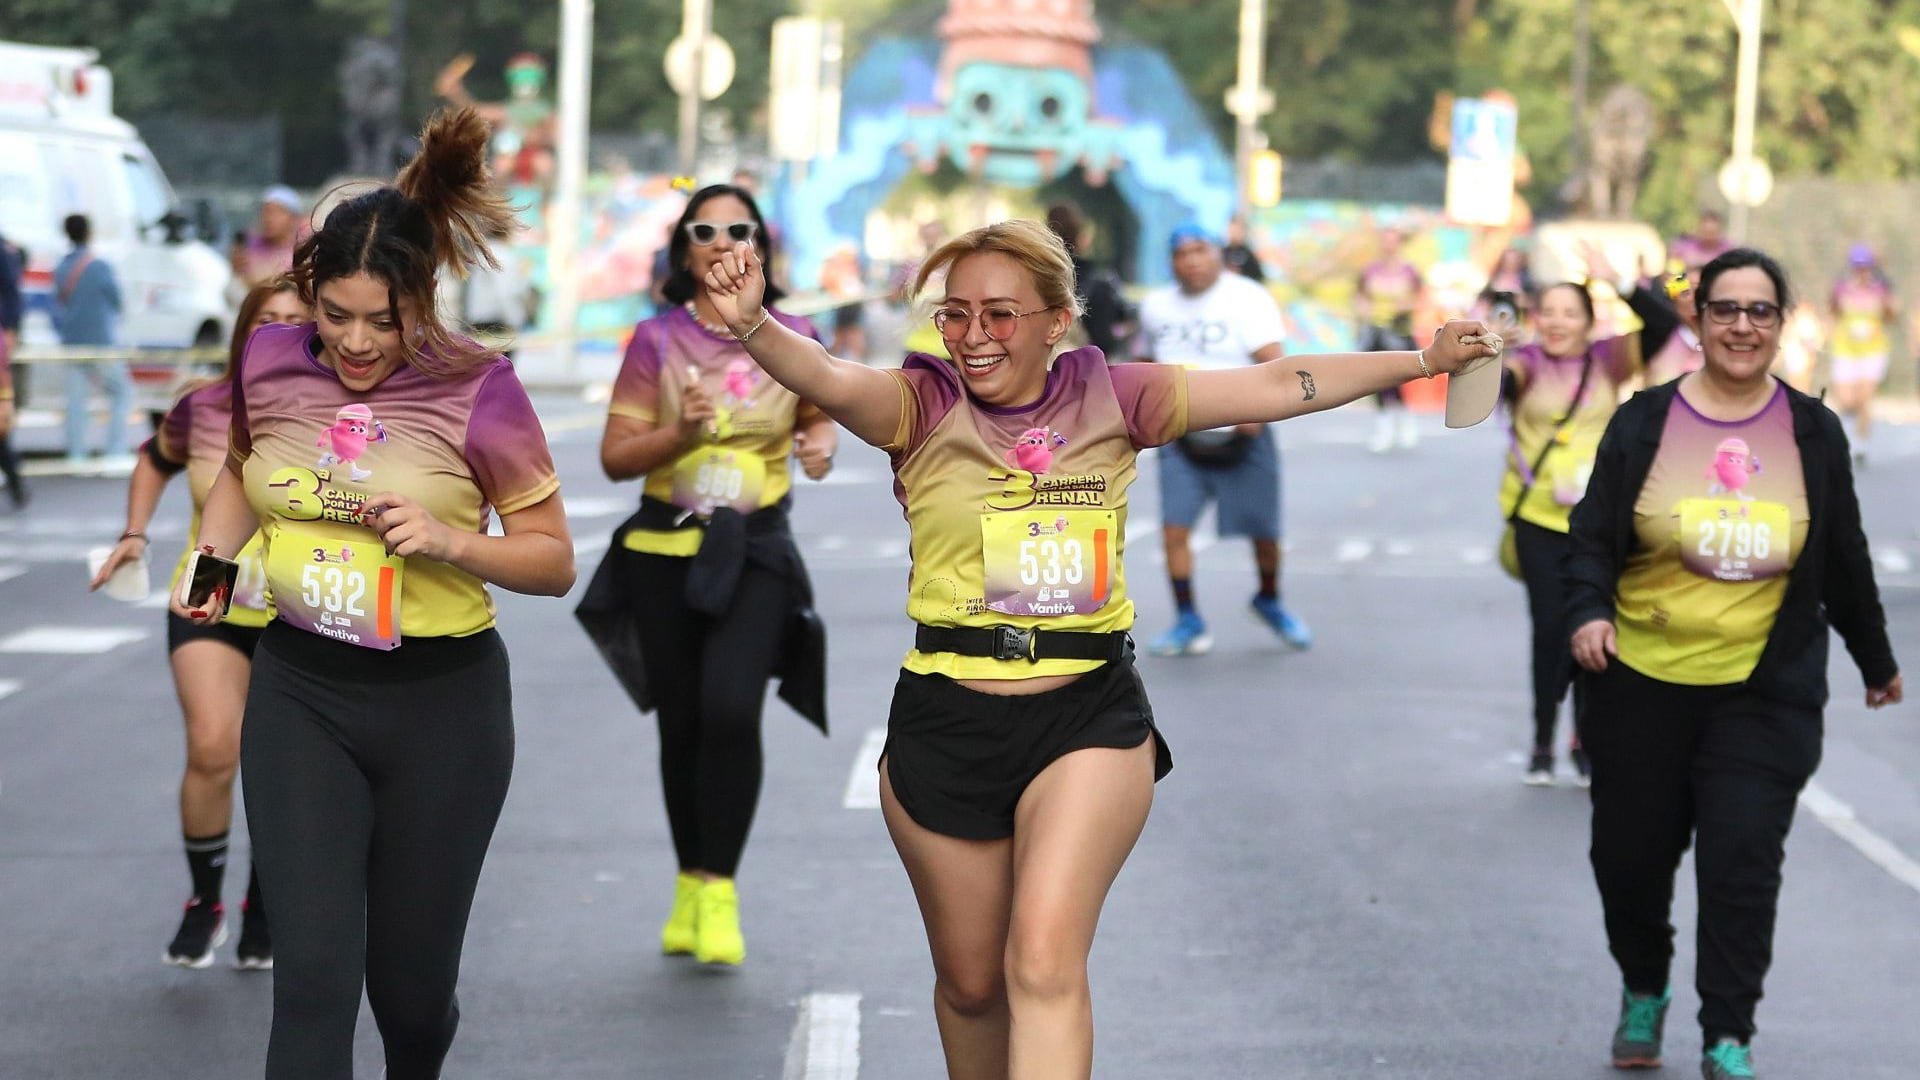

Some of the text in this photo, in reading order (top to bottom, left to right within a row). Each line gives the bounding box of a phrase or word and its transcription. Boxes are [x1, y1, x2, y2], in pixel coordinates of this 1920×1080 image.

[1040, 475, 1105, 489] CARRERA
[325, 488, 369, 503] CARR
[1036, 491, 1102, 505] RENAL
[323, 499, 345, 509] POR
[323, 507, 364, 524] REN
[1697, 519, 1770, 560] 2796
[1019, 539, 1083, 586] 533
[301, 564, 366, 617] 532
[1027, 602, 1076, 614] Vantive
[313, 622, 360, 643] Vantive
